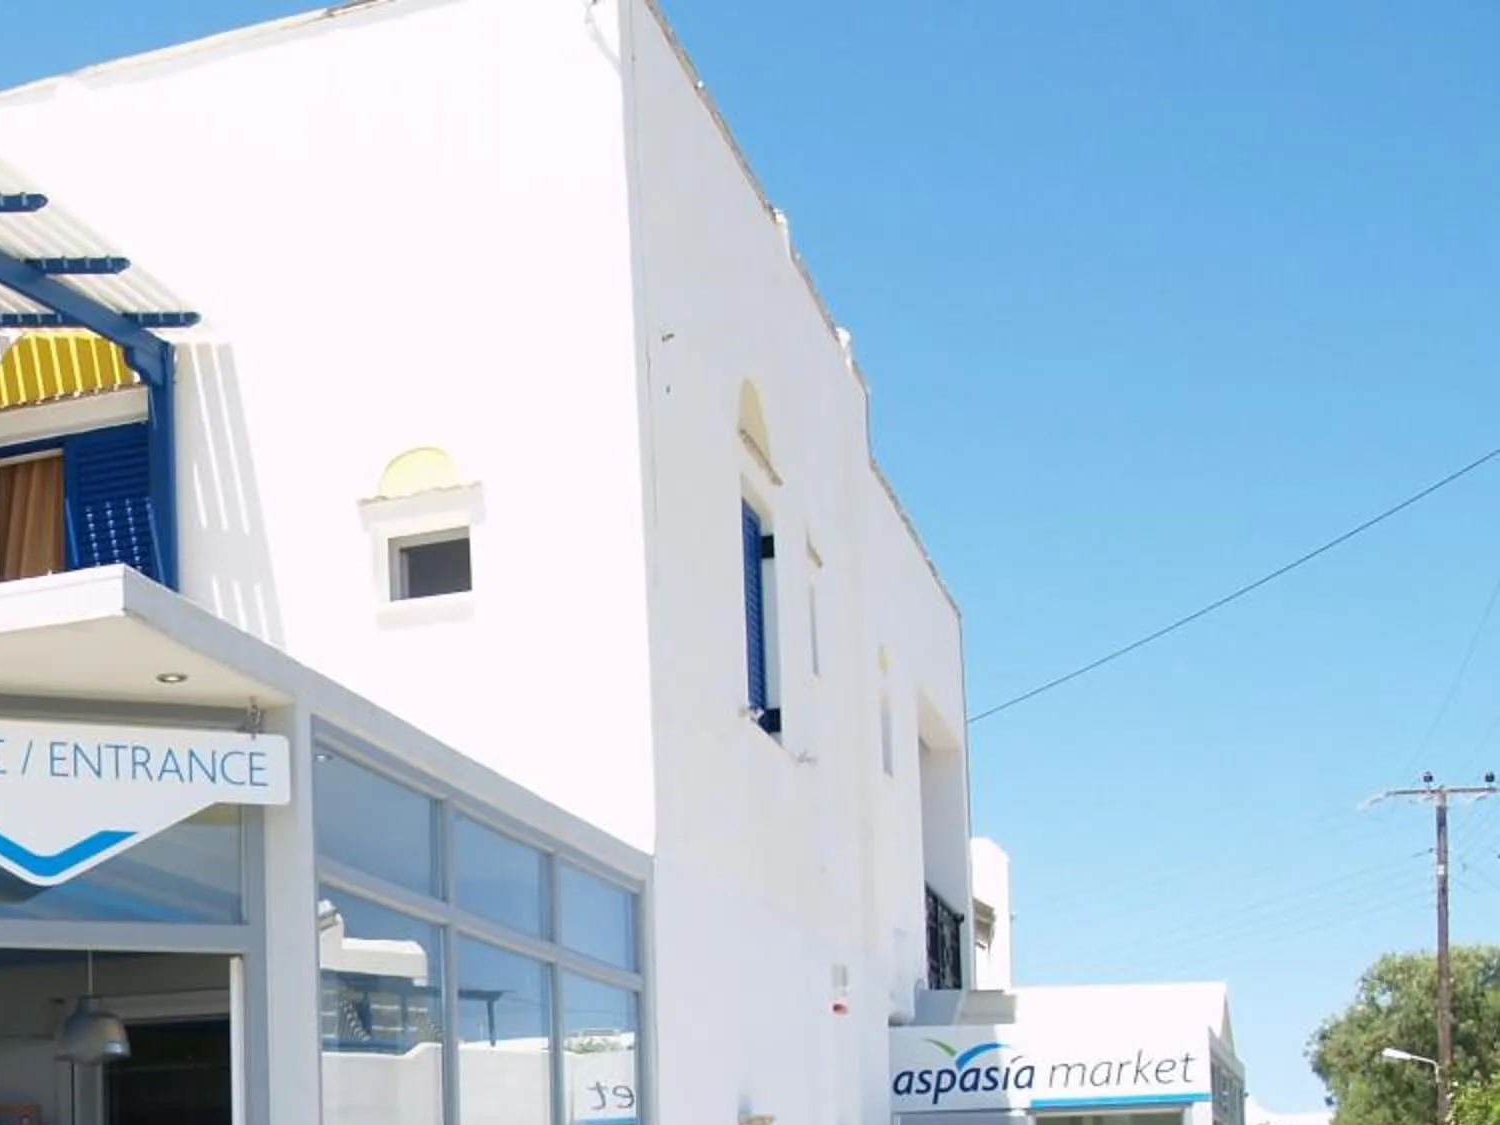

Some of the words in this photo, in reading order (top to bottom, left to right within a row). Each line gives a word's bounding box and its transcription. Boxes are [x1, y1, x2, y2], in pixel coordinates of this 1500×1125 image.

[20, 741, 34, 776] /
[50, 741, 269, 787] ENTRANCE
[1049, 1050, 1197, 1088] market
